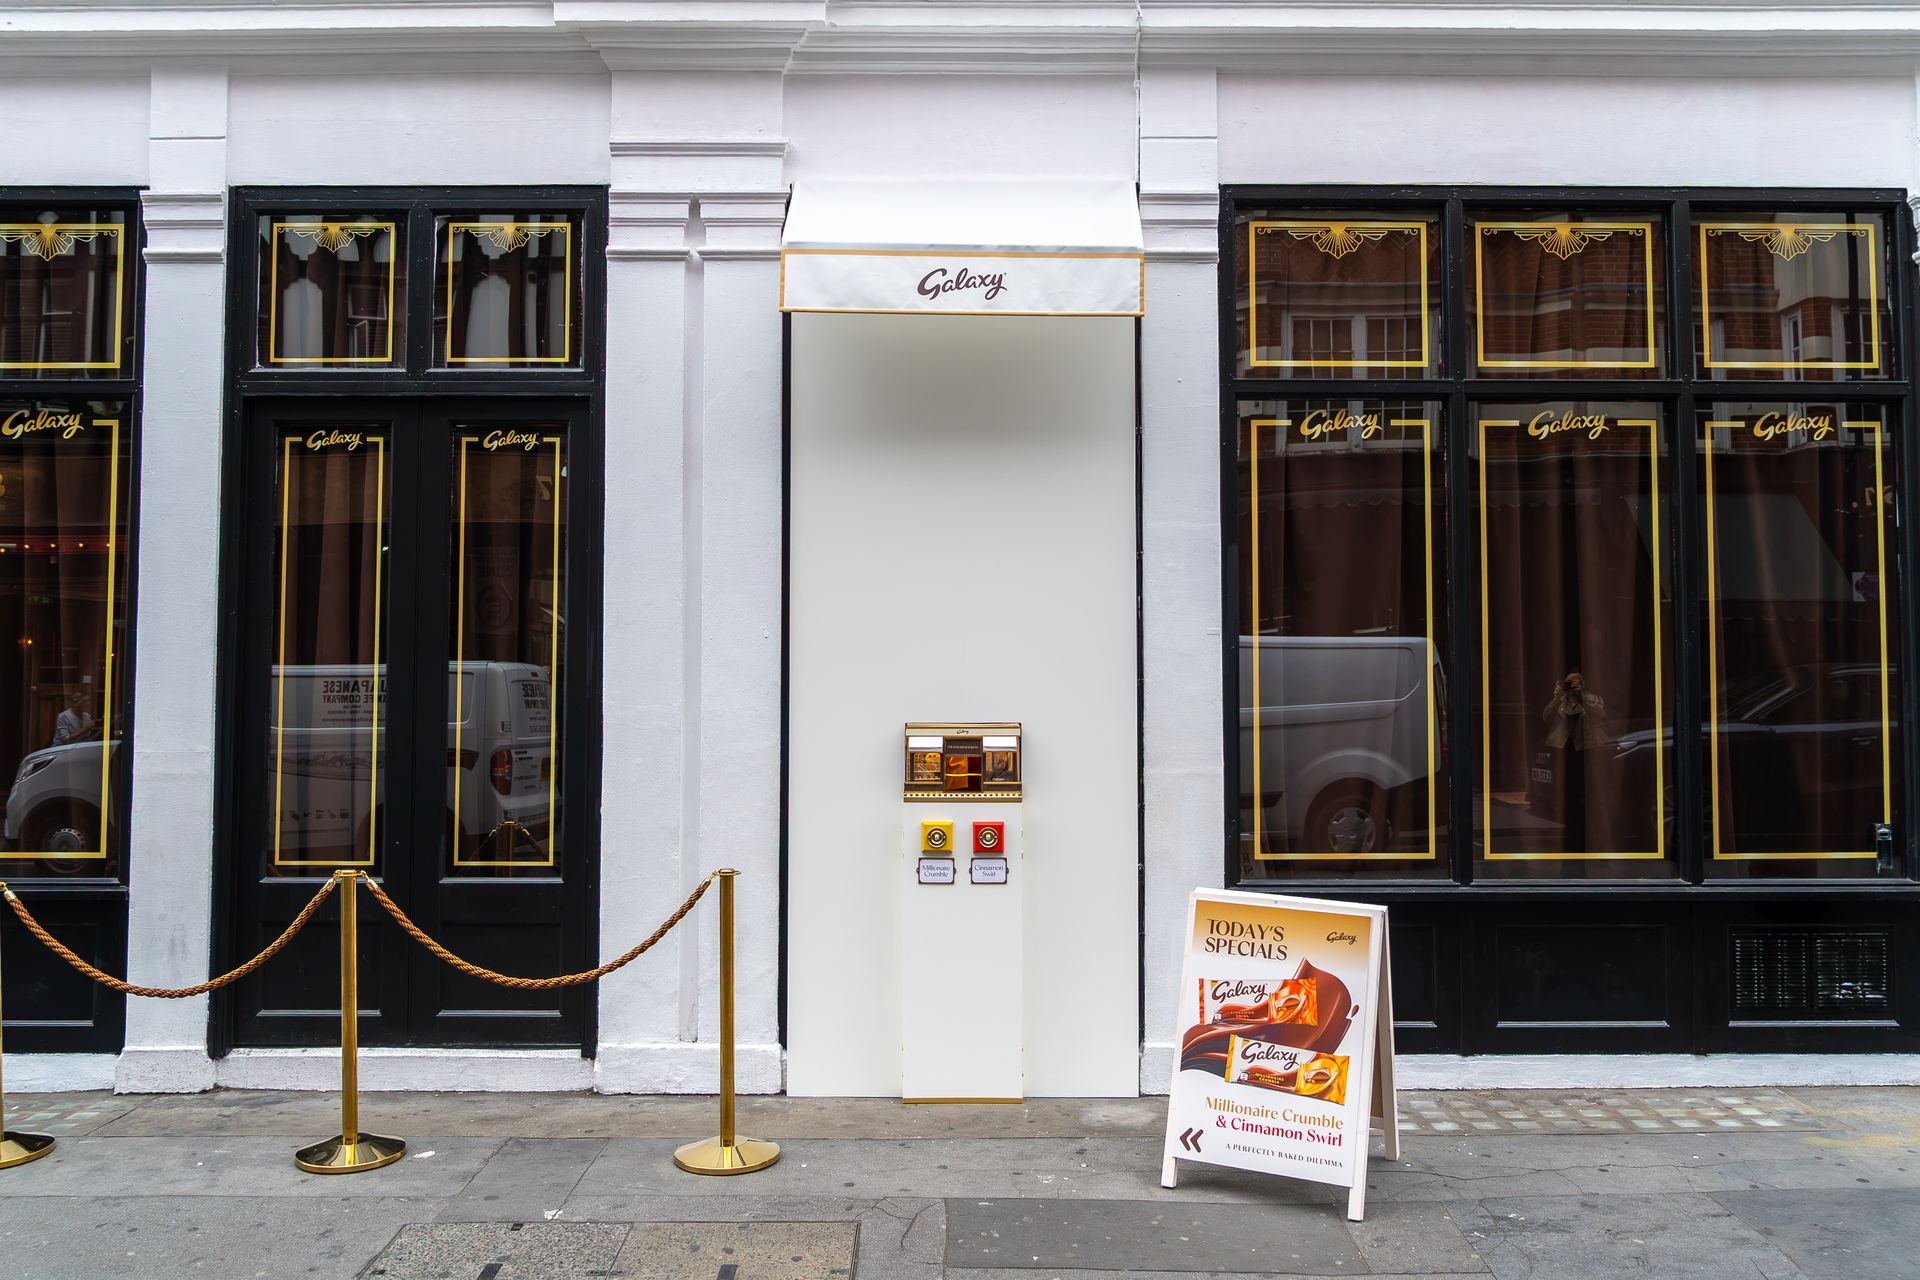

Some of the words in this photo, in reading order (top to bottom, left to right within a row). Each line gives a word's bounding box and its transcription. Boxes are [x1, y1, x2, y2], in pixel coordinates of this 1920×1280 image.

[917, 267, 1007, 301] Galaxy
[2, 409, 84, 439] Galaxy
[1300, 409, 1382, 439] Galaxy
[1528, 409, 1609, 439] Galaxy
[1754, 411, 1834, 440] Galaxy
[306, 429, 363, 451] Galaxy
[483, 429, 540, 451] Galaxy
[922, 864, 950, 872] Millionaire
[974, 864, 1004, 872] Cinnamon
[1207, 918, 1285, 941] TODAY'S
[1326, 931, 1357, 945] Galaxy
[1204, 937, 1288, 961] SPECIALS
[1211, 980, 1269, 1004] Galaxy
[1240, 1042, 1300, 1071] Galaxy
[1205, 1096, 1279, 1120] Millionaire
[1282, 1108, 1344, 1130] Crumble
[1215, 1114, 1227, 1129] &
[1231, 1117, 1303, 1141] Cinnamon
[1306, 1129, 1343, 1147] Swirl
[1232, 1144, 1276, 1157] PERFECTLY
[1278, 1151, 1304, 1162] BAKED
[1306, 1155, 1343, 1168] DILEMMA
